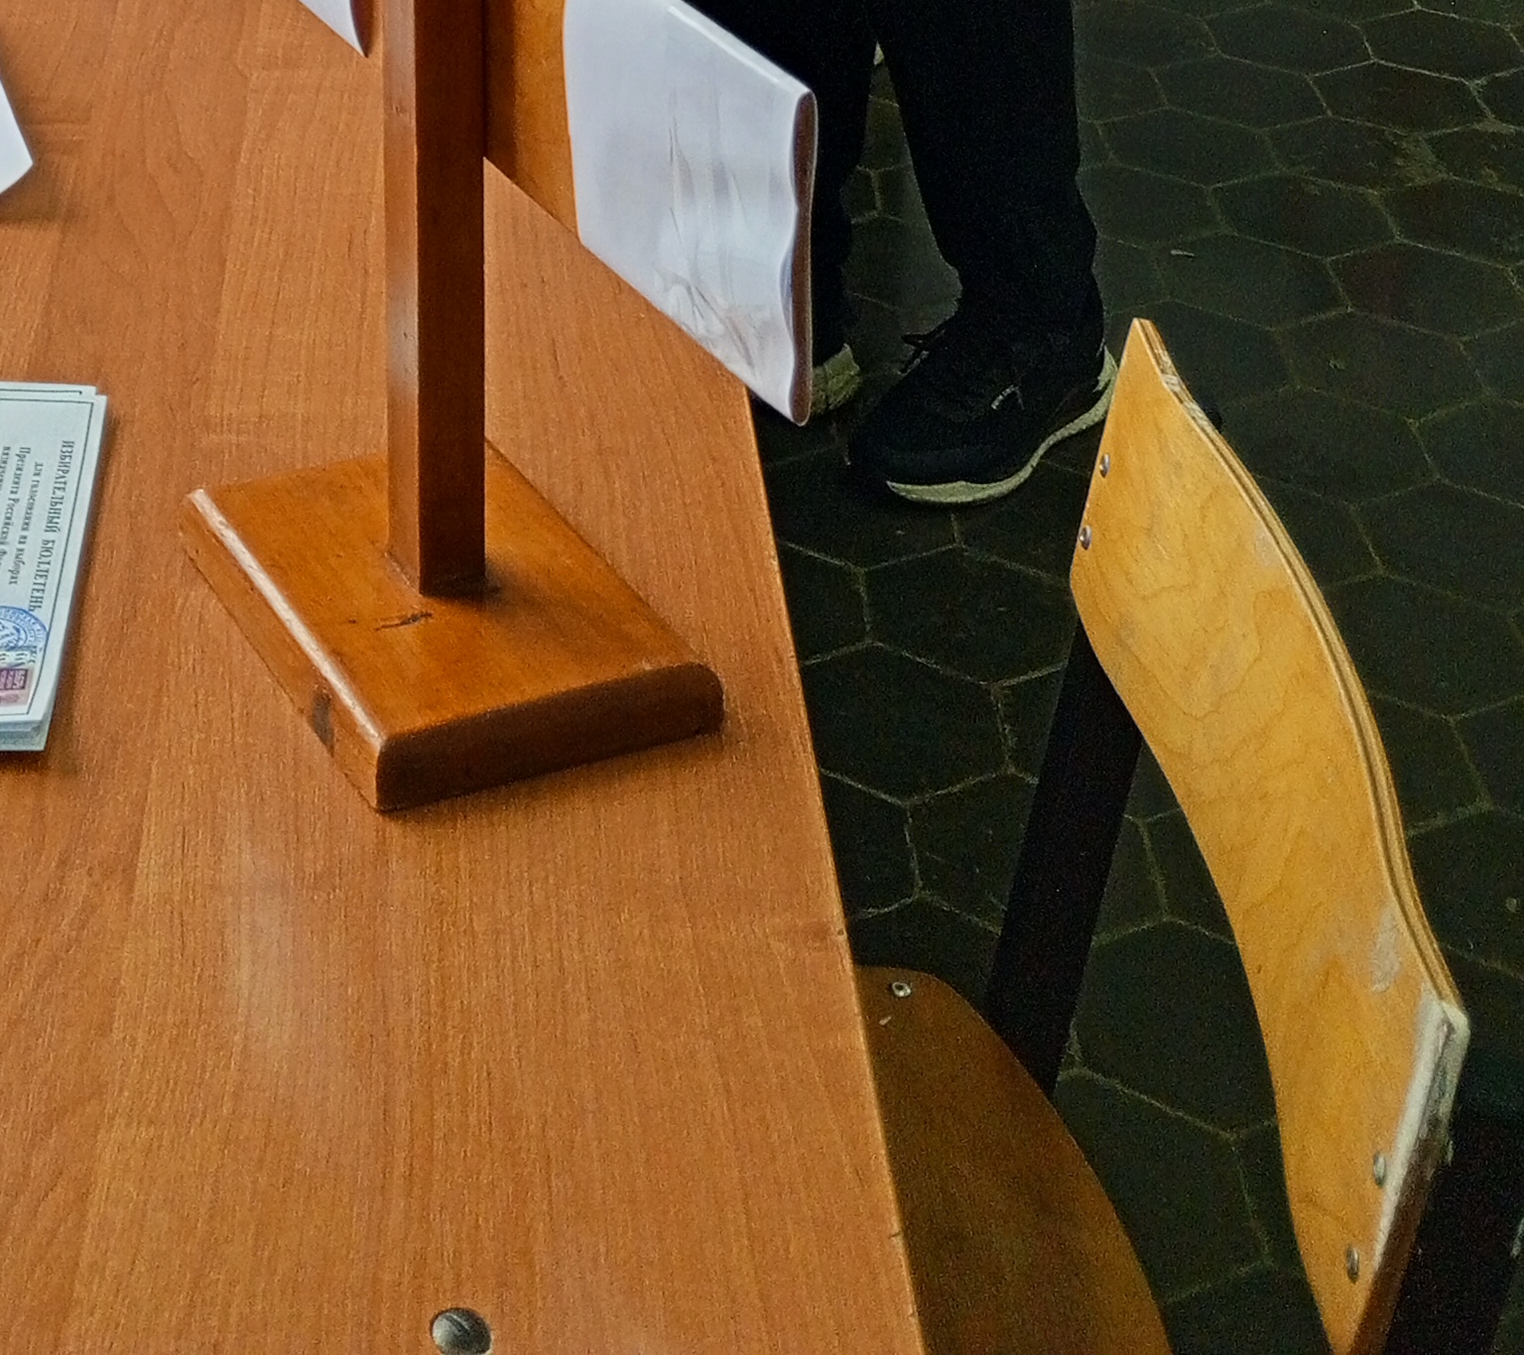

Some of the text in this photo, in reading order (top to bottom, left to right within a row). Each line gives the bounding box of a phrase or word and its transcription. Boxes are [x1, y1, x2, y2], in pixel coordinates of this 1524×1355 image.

[9, 446, 32, 495] Президента
[28, 440, 75, 612] ИЗБИРАТЕЛЬНЫЙ БЮЛЛЕТЕНЬ
[7, 547, 26, 586] выборах
